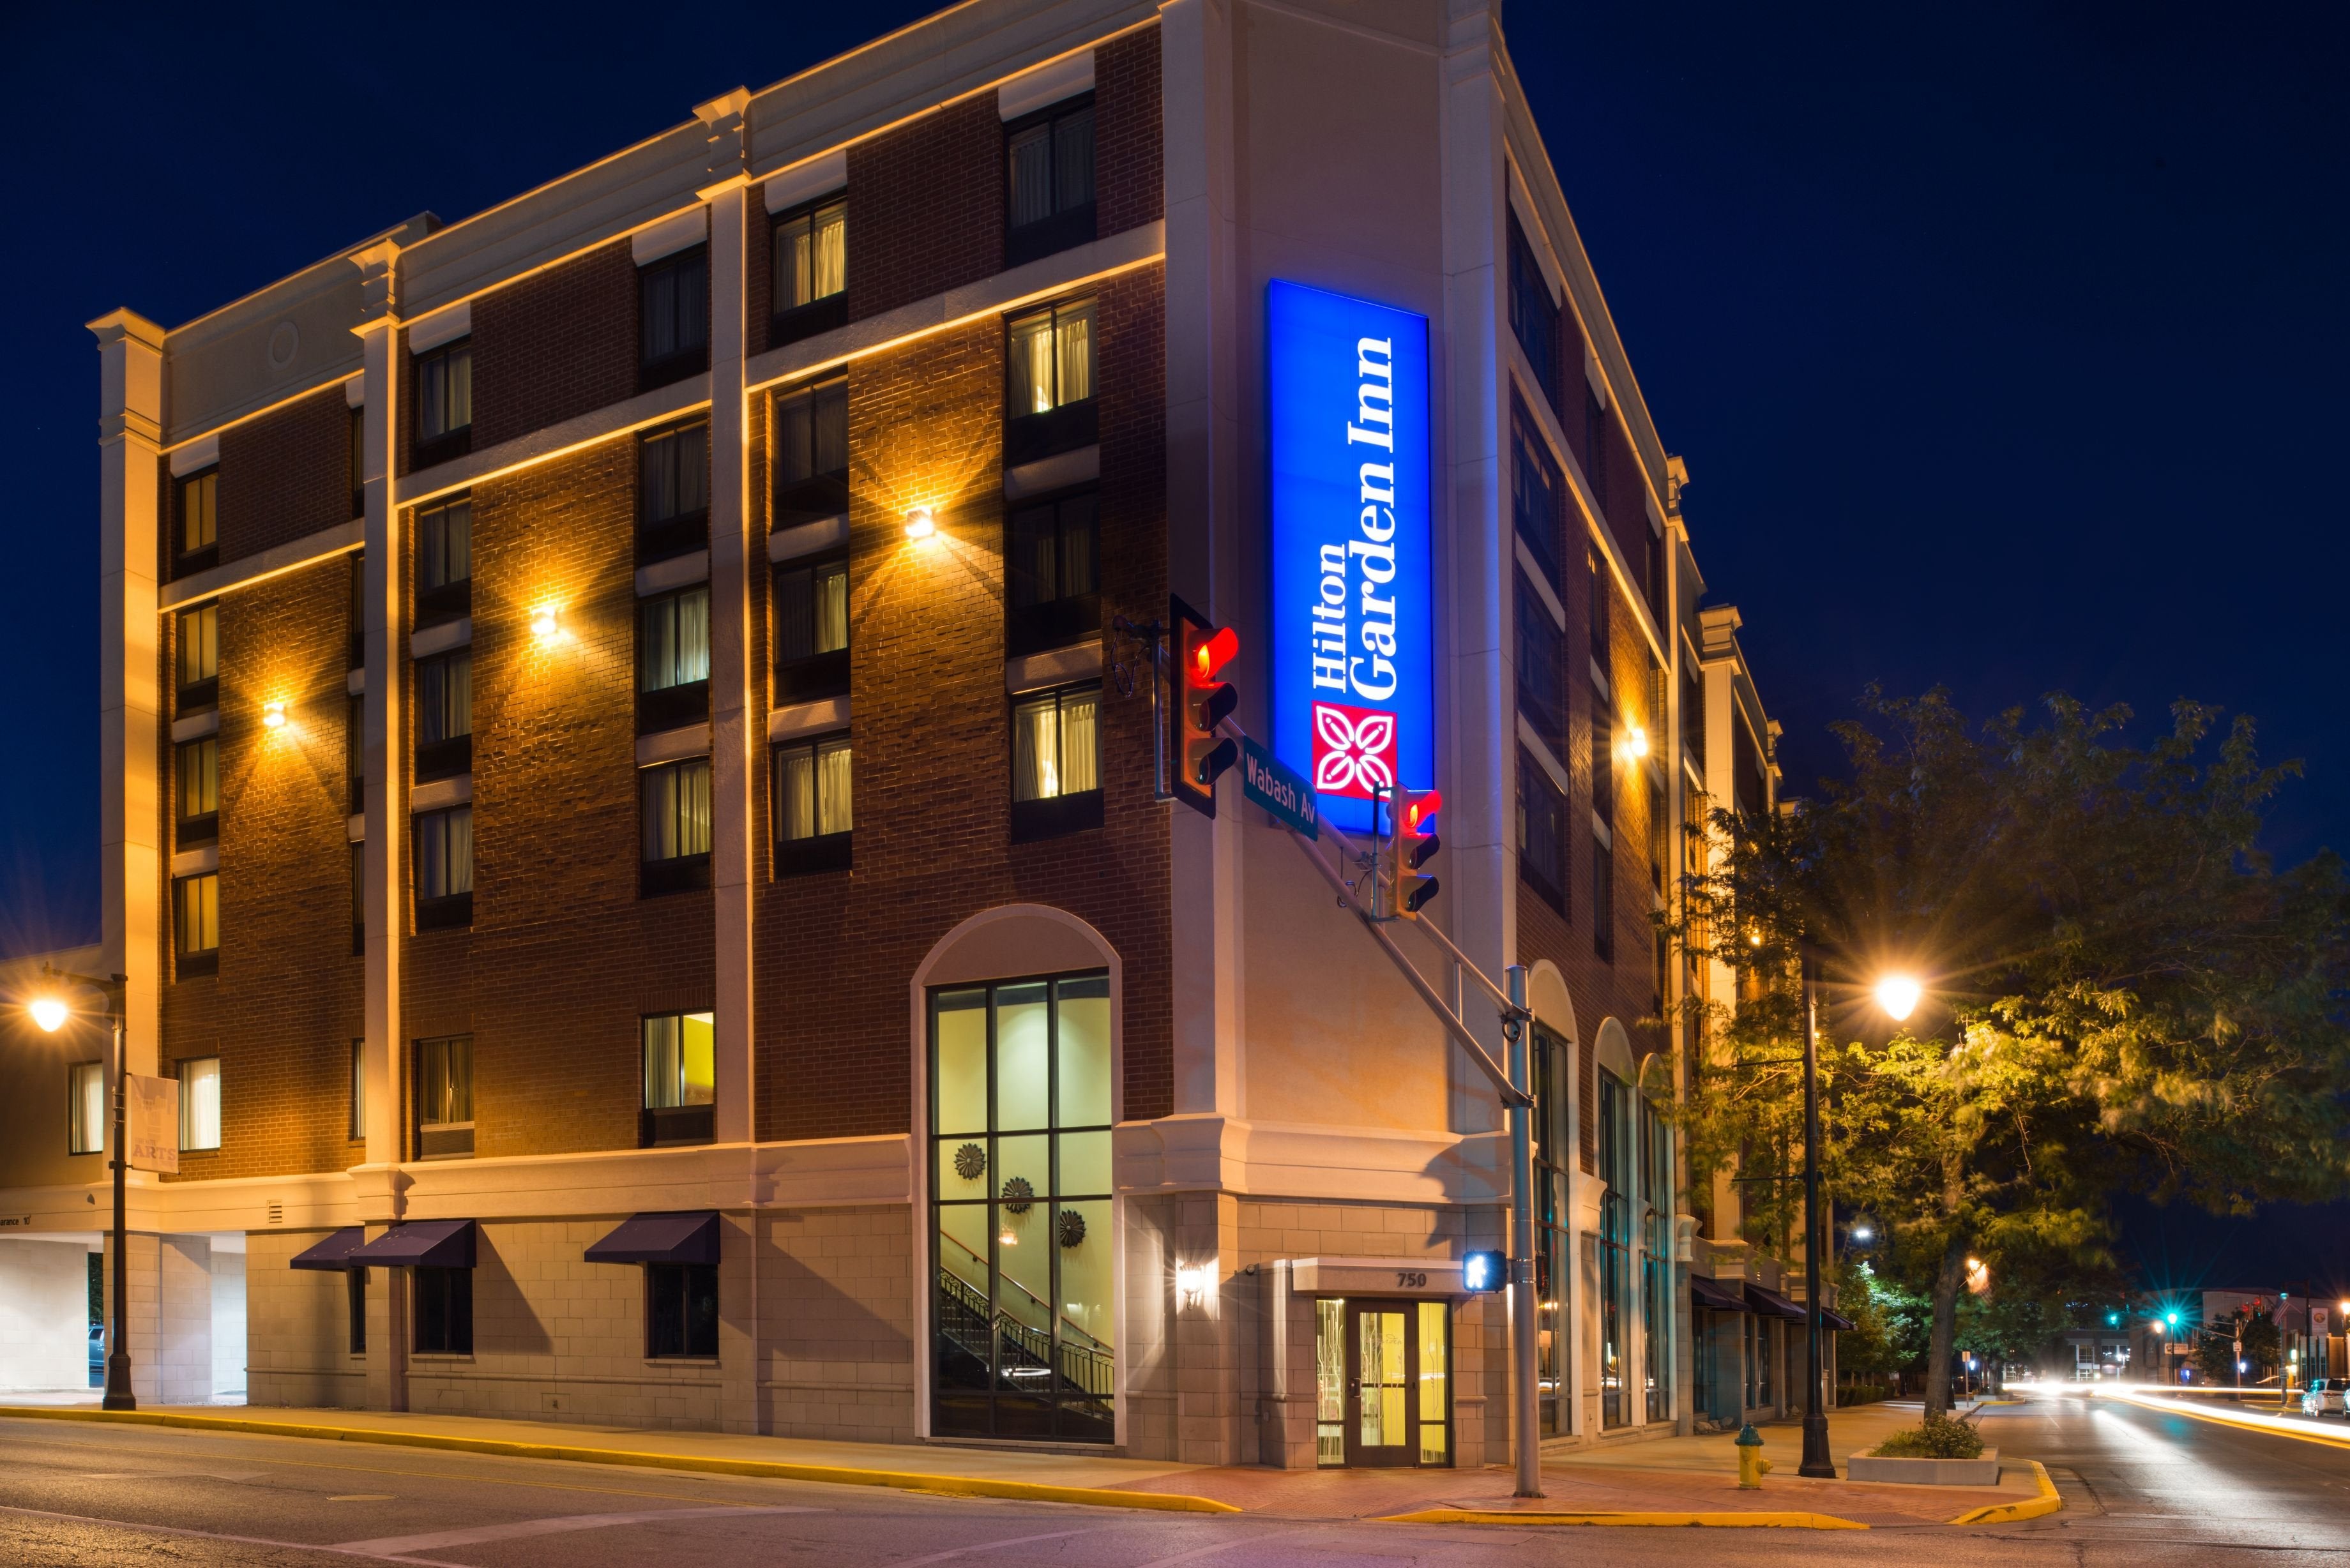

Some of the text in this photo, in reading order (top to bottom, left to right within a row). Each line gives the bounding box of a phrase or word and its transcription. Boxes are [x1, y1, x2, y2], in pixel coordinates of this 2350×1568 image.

[1347, 337, 1397, 700] Garden Inn
[1312, 544, 1346, 693] Hilton
[1247, 753, 1315, 824] Wabash Av
[132, 1144, 177, 1161] ARTS
[1398, 1273, 1427, 1287] 750
